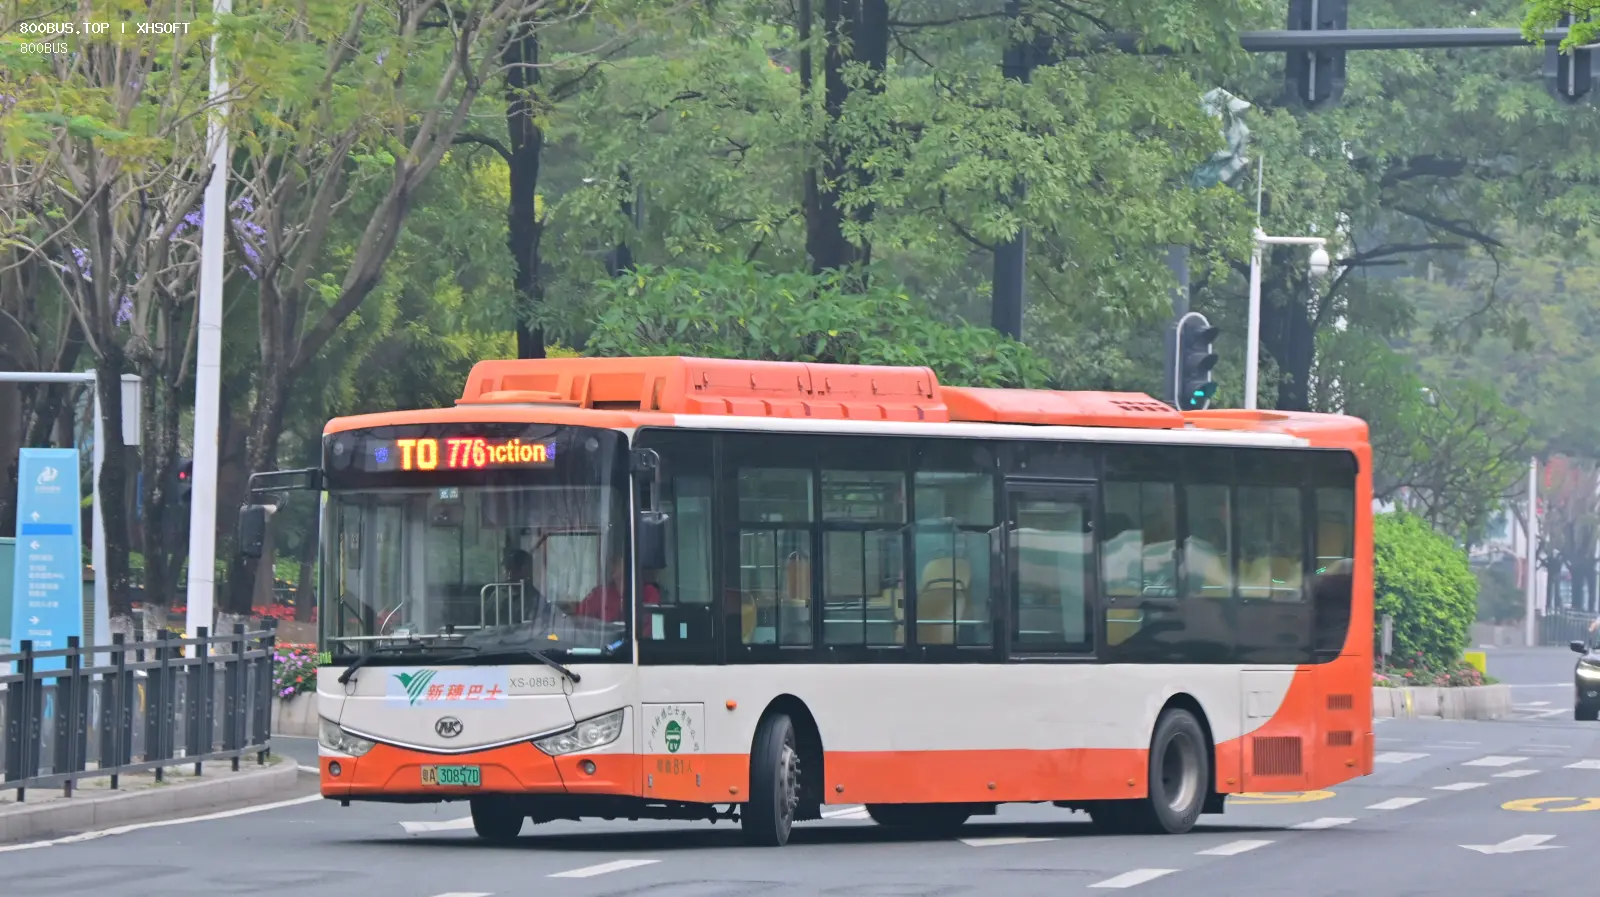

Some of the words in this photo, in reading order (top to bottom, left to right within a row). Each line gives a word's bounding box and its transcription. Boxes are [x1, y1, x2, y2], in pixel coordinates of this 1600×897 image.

[397, 438, 439, 471] TO
[447, 438, 486, 468] 776
[509, 677, 556, 688] XS-0863
